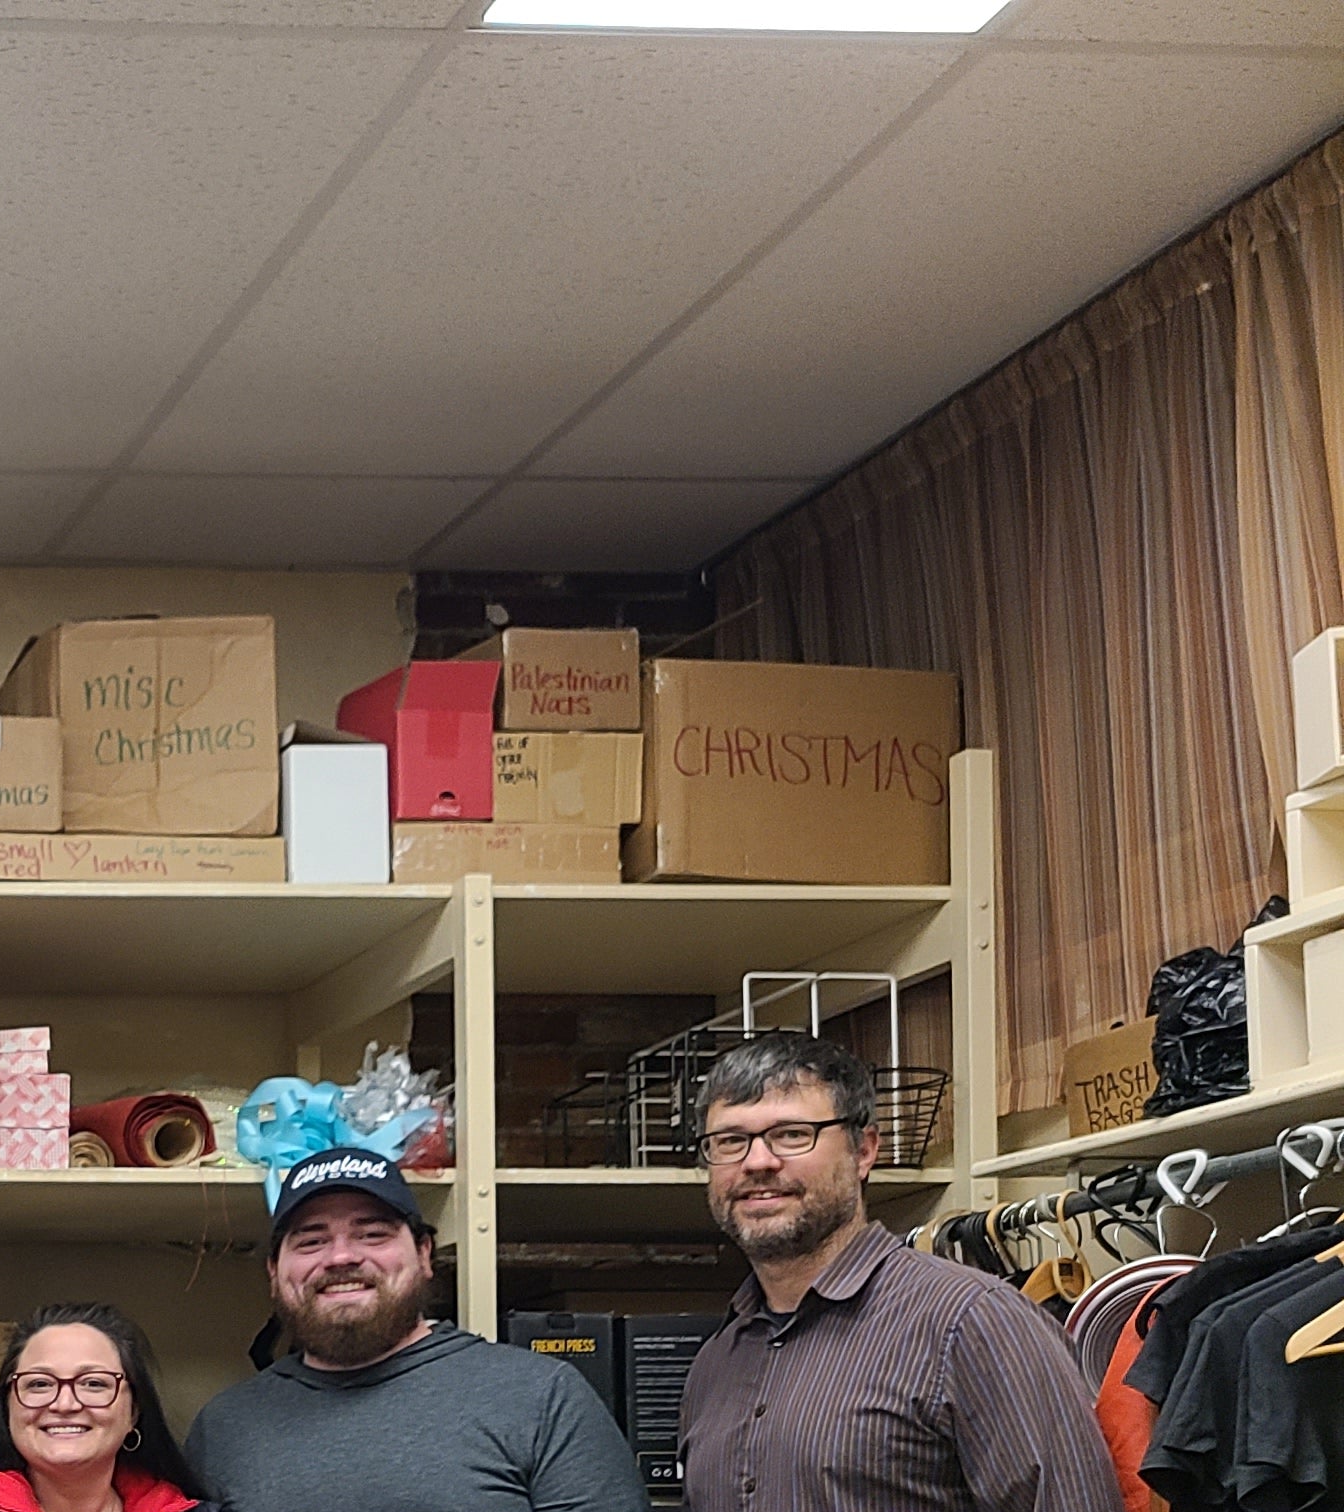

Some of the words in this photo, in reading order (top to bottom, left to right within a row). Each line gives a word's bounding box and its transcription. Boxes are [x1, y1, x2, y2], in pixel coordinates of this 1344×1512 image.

[83, 666, 186, 711] misc
[512, 663, 629, 694] Palestinian
[95, 719, 255, 766] Christmas
[673, 725, 945, 807] CHRISTMAS
[3, 859, 41, 879] red
[1074, 1061, 1150, 1110] TRASH
[1088, 1096, 1145, 1133] BAGS
[530, 1339, 565, 1353] FRENCH
[566, 1339, 597, 1352] PRESS
